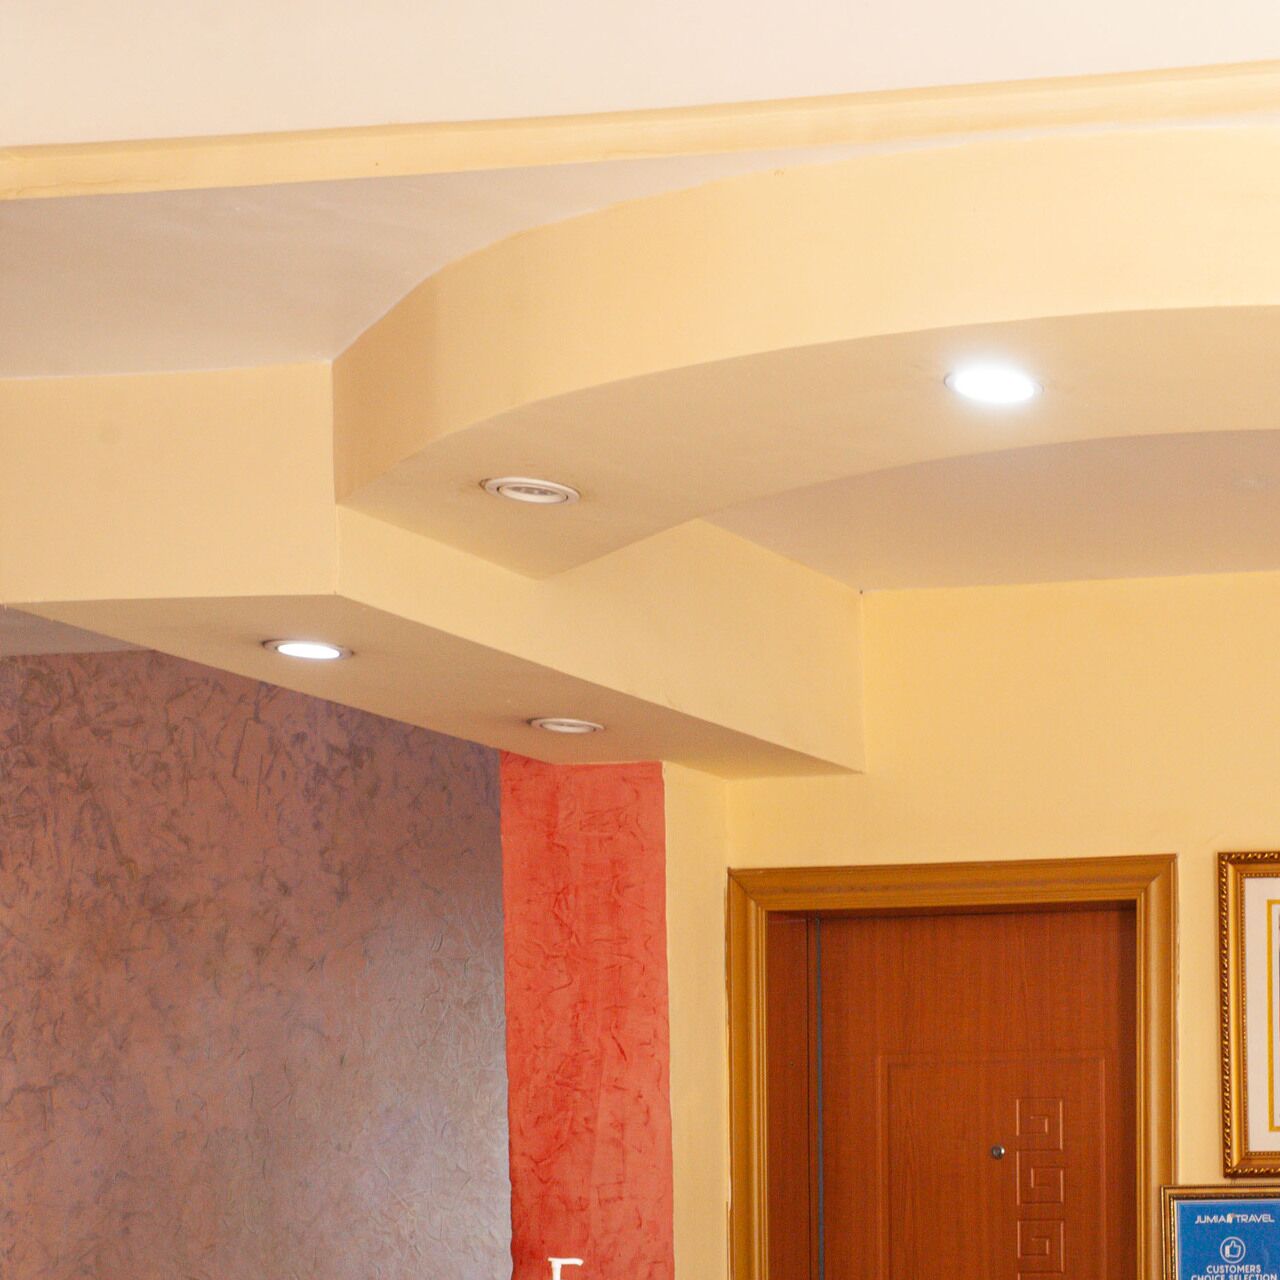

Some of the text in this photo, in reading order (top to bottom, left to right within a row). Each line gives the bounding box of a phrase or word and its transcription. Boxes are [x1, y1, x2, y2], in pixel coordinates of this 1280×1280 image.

[1195, 1213, 1275, 1225] JUMIA TRAVEL
[1206, 1264, 1262, 1274] CUSTOMERS
